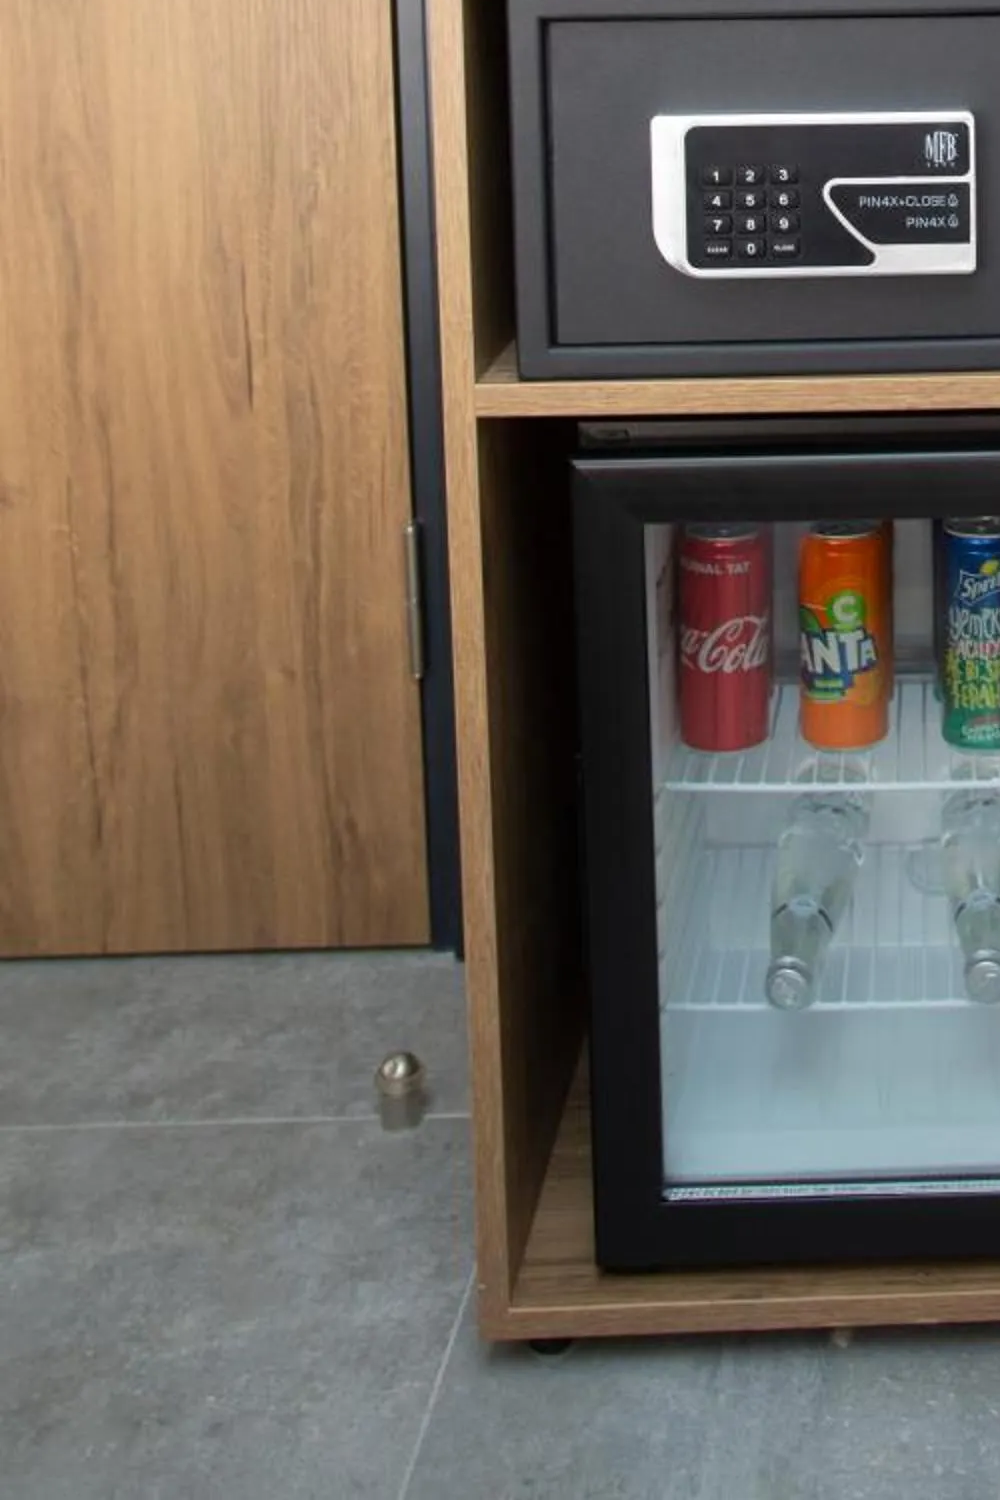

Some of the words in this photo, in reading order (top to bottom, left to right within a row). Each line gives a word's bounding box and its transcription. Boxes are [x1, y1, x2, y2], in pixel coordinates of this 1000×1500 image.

[712, 170, 719, 182] 1
[745, 169, 755, 182] 2
[778, 168, 789, 181] 3
[711, 195, 721, 207] 4
[745, 194, 755, 207] 5
[779, 192, 789, 206] 6
[712, 219, 723, 232] 7
[746, 218, 756, 231] 8
[779, 217, 789, 230] 9
[746, 242, 756, 256] 0
